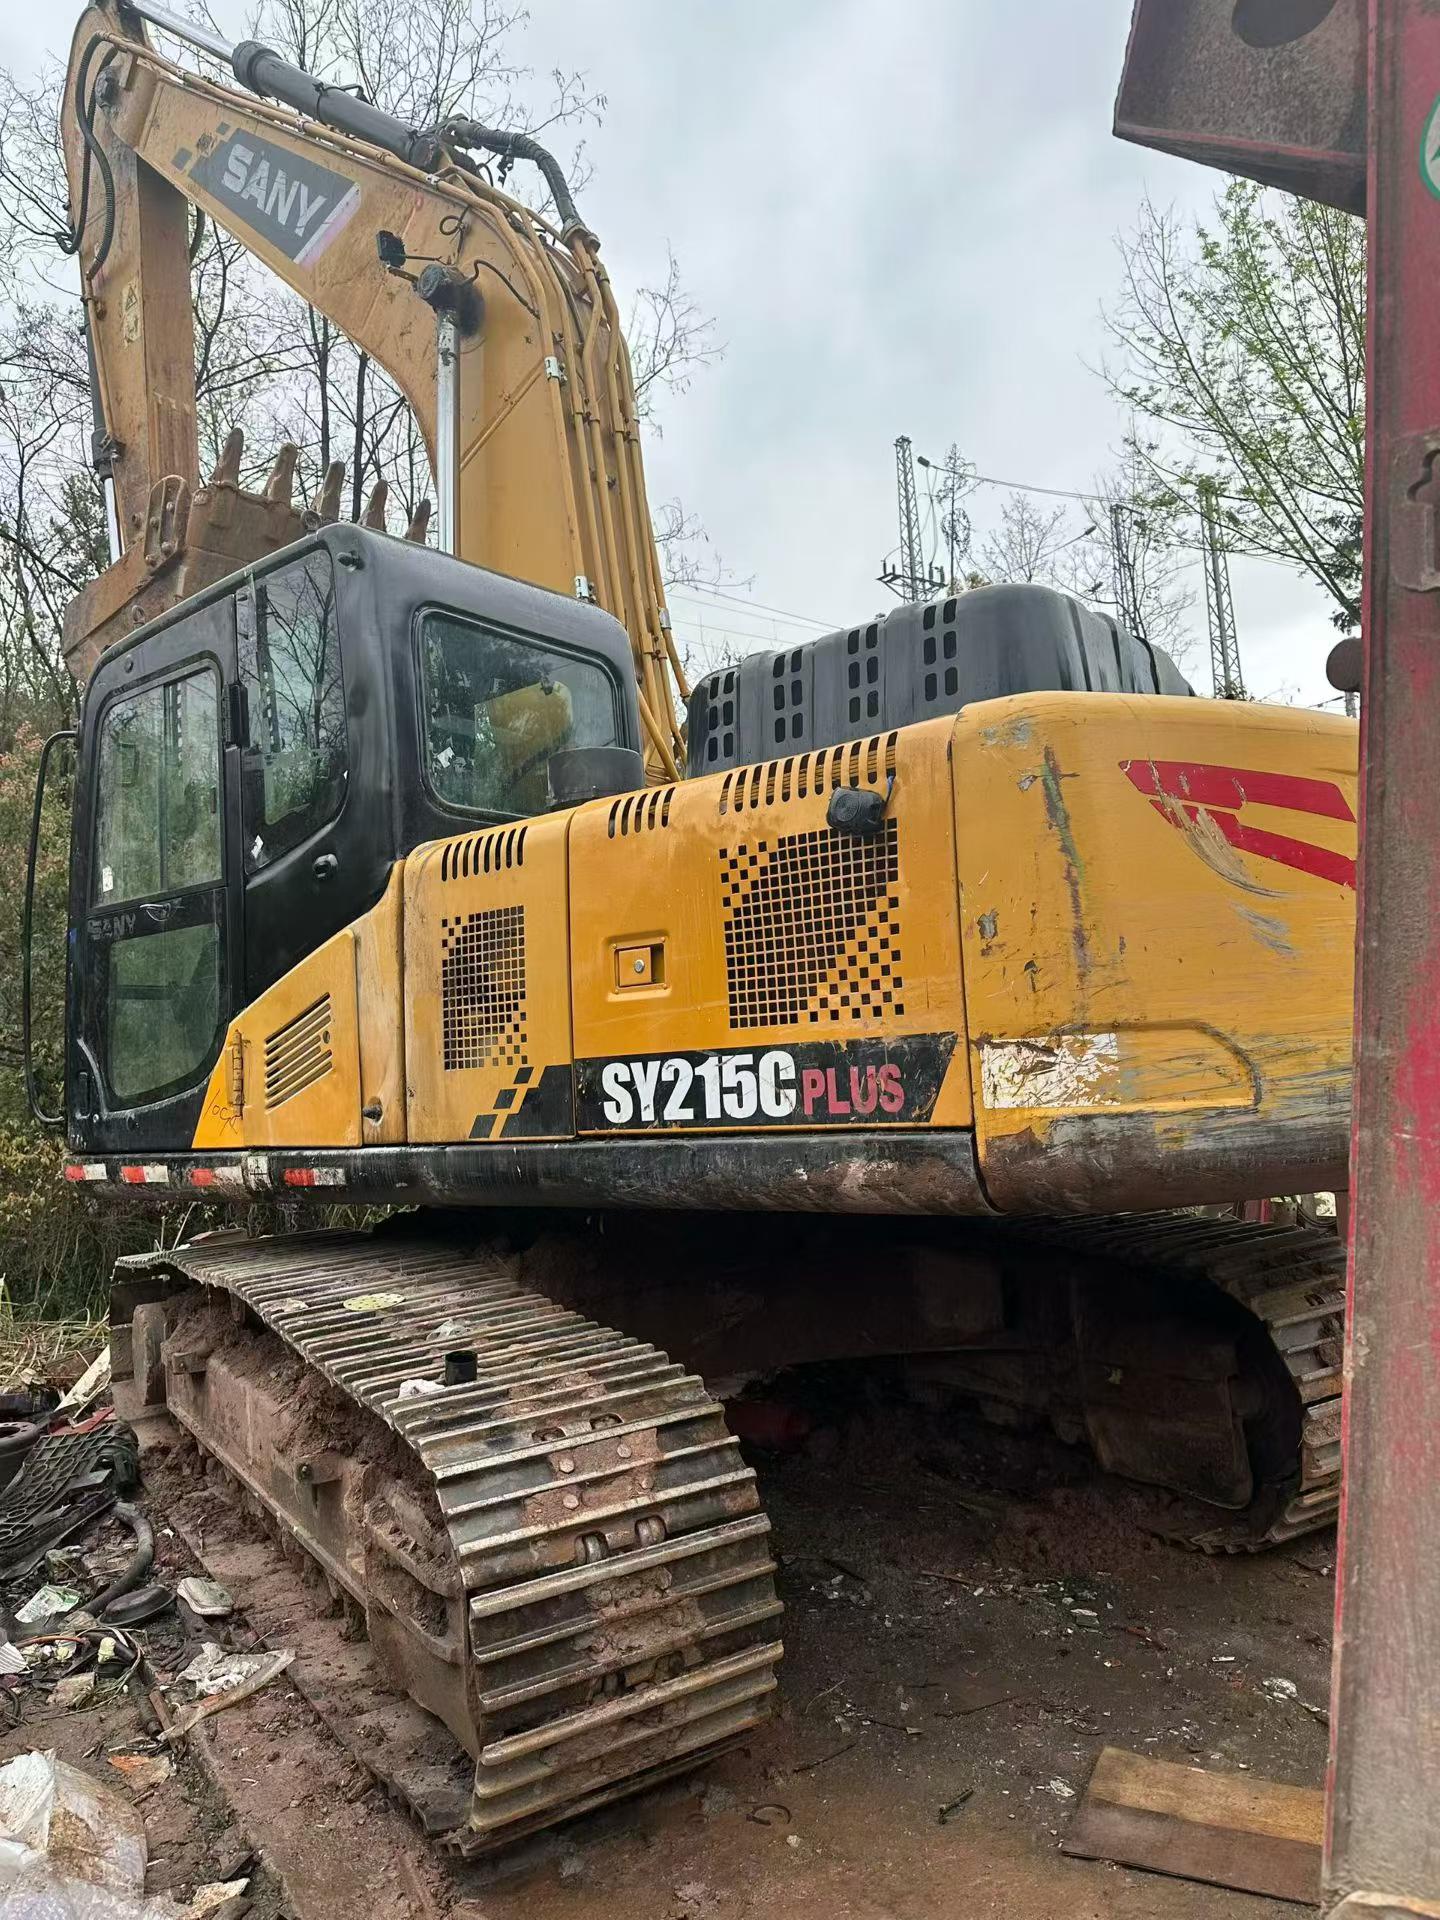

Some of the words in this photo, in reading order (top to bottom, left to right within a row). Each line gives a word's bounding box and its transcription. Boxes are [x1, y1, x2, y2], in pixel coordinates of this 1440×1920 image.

[221, 144, 327, 237] SANY
[87, 912, 136, 940] SANY
[601, 1050, 796, 1124] SY215C
[802, 1063, 905, 1116] PLUS
